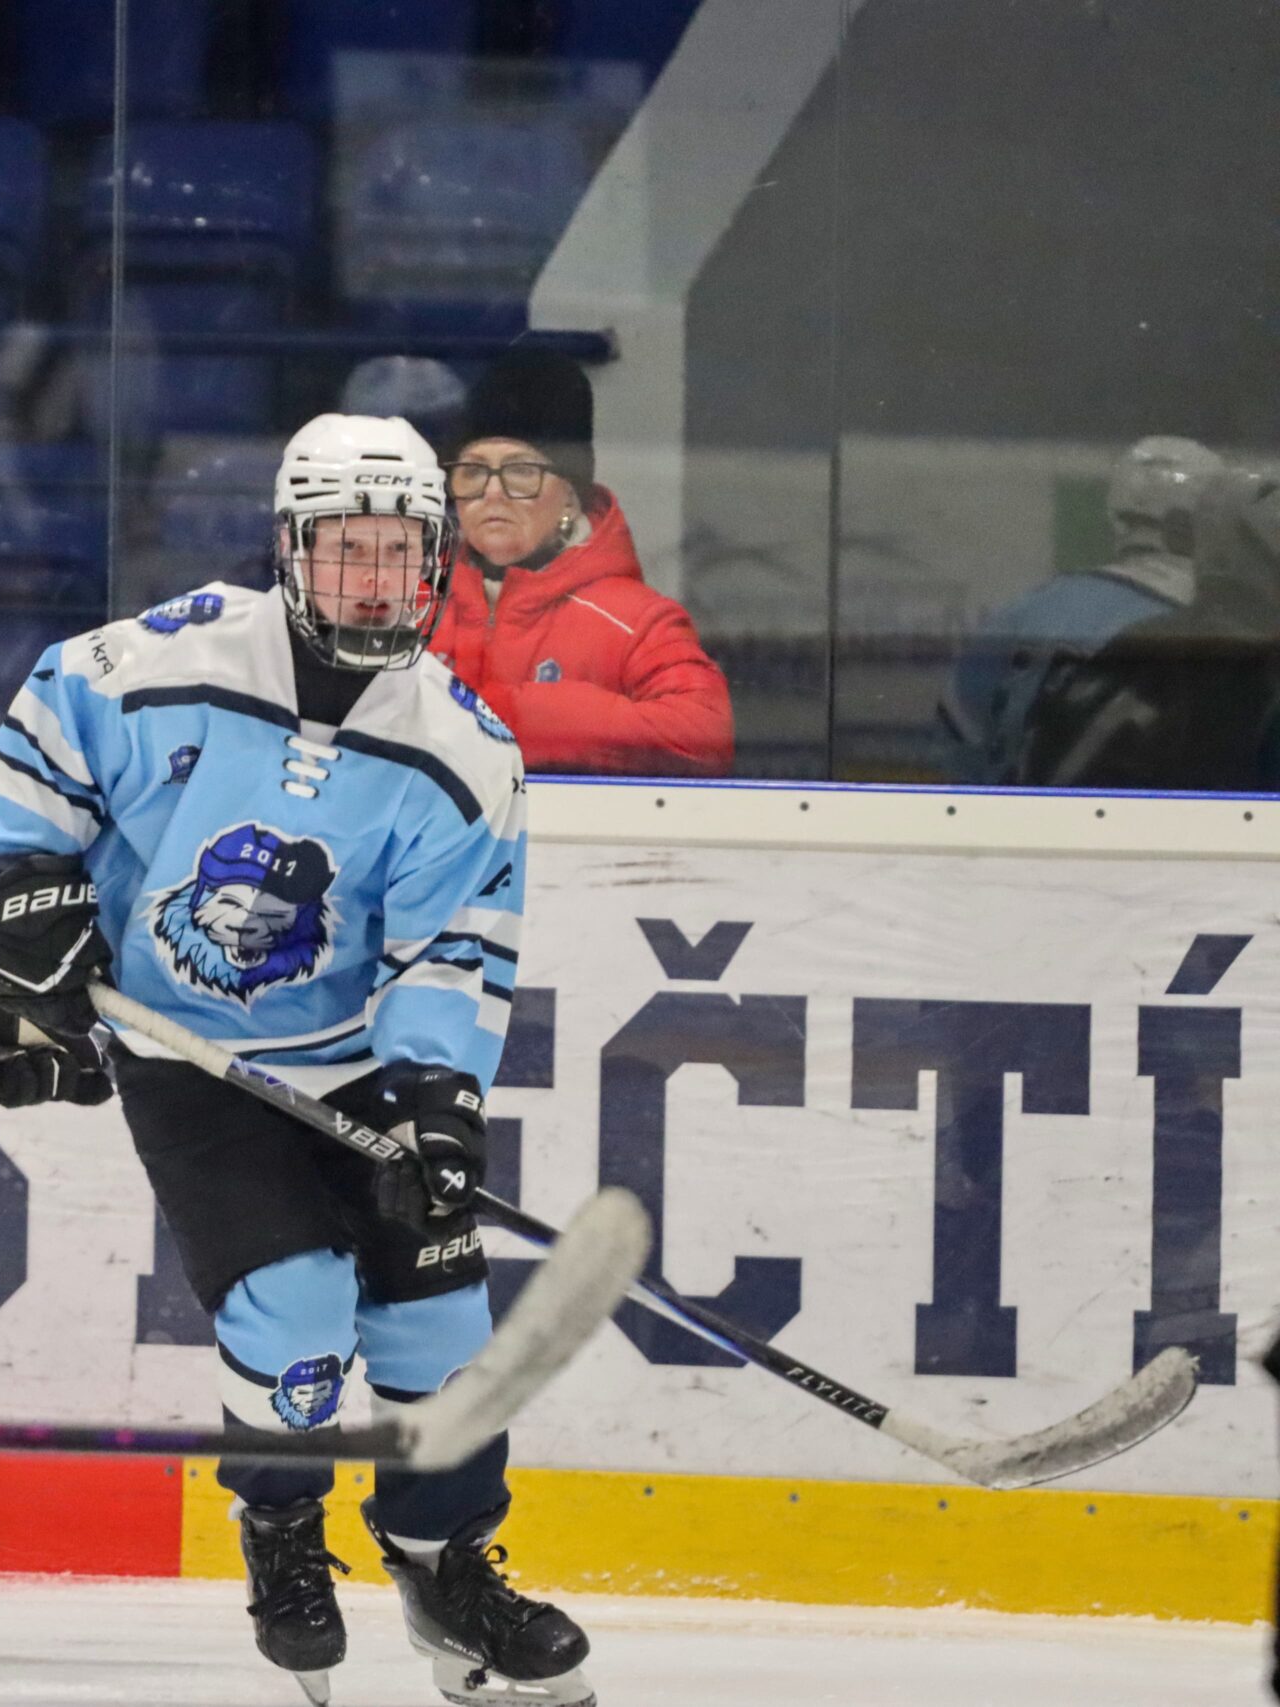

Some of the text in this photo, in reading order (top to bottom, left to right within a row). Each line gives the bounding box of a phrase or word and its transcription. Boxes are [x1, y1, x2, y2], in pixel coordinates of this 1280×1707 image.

[354, 474, 413, 487] CCM
[239, 842, 298, 877] 2017
[786, 1366, 884, 1420] FLYLITE
